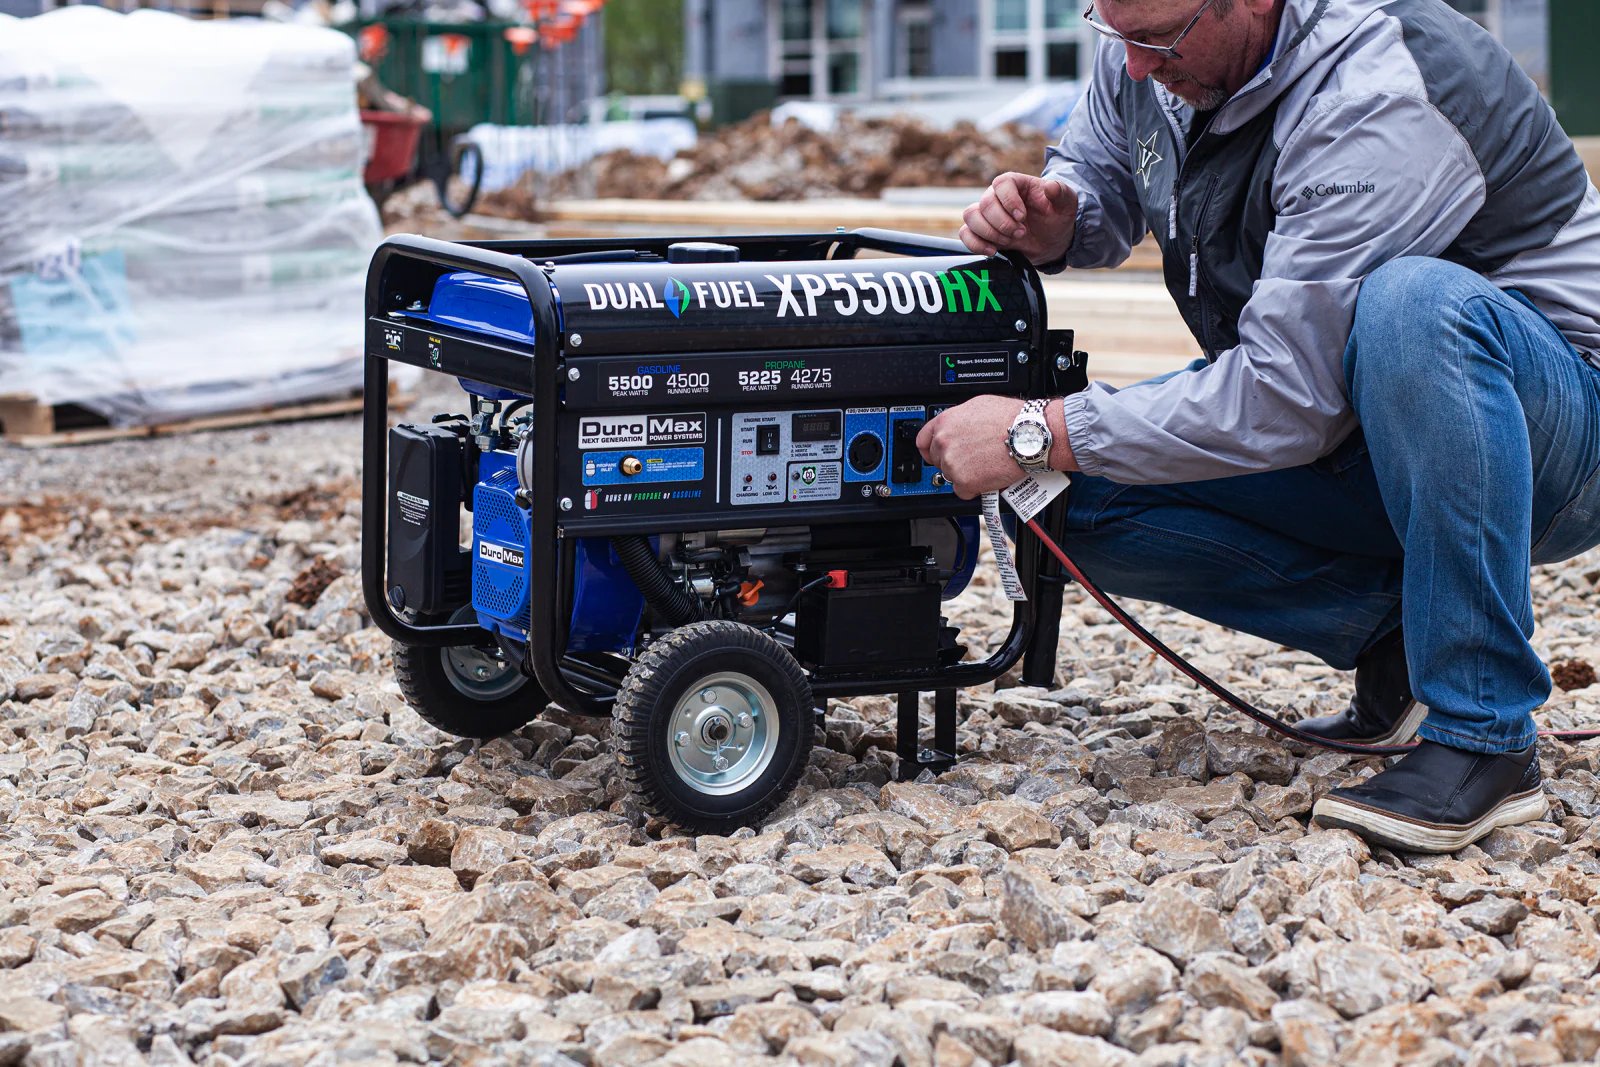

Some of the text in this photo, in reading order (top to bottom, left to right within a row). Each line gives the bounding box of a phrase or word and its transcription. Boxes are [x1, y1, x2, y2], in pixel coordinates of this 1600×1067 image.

[1315, 180, 1376, 197] Columbia
[583, 269, 1003, 318] DUAL FUEL XP5500HX
[637, 364, 681, 375] GASOLINE
[765, 360, 806, 370] PROPANE
[608, 372, 710, 391] 5500 4500
[738, 368, 832, 386] 5225 4275
[582, 418, 702, 437] DuroMax
[601, 436, 643, 444] GENERATION
[1012, 475, 1033, 493] HUSKY
[605, 494, 621, 502] RUNS
[623, 493, 632, 501] ON
[633, 491, 662, 501] PROPANE
[672, 490, 702, 499] GASOLINE
[481, 544, 524, 565] DuroMax
